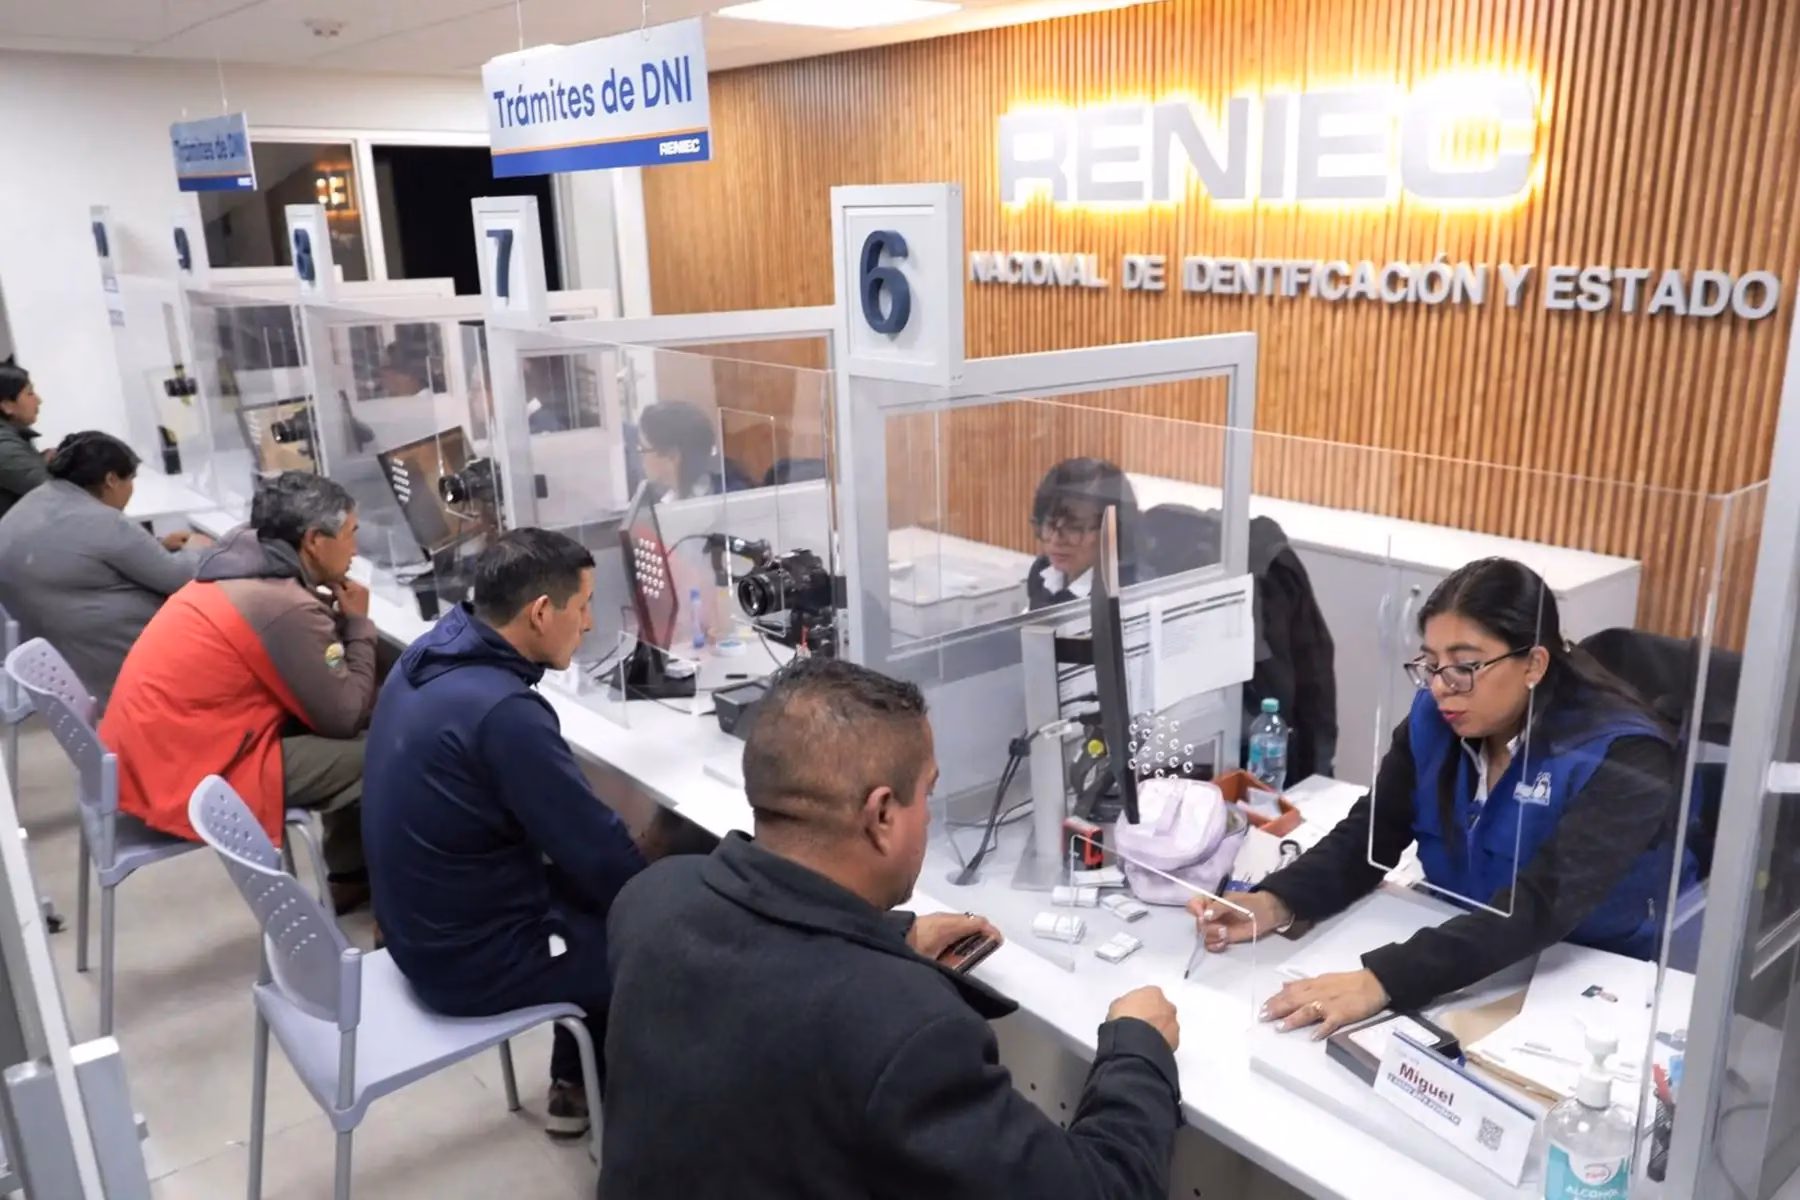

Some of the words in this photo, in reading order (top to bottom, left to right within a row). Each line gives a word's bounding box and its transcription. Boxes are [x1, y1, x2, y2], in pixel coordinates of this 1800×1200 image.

[493, 78, 596, 129] Trámites
[601, 67, 636, 115] de
[641, 55, 693, 109] DNI
[658, 138, 701, 157] RENIEC
[998, 78, 1535, 203] RENIEC
[294, 227, 316, 282] 8
[486, 228, 514, 299] 7
[860, 229, 912, 335] 6
[970, 250, 1109, 288] NACIONAL
[1122, 254, 1167, 291] DE
[1182, 250, 1488, 305] IDENTIFICACIÓN
[1498, 261, 1536, 308] Y
[1545, 264, 1781, 320] ESTADO
[1399, 1062, 1455, 1107] Miguel
